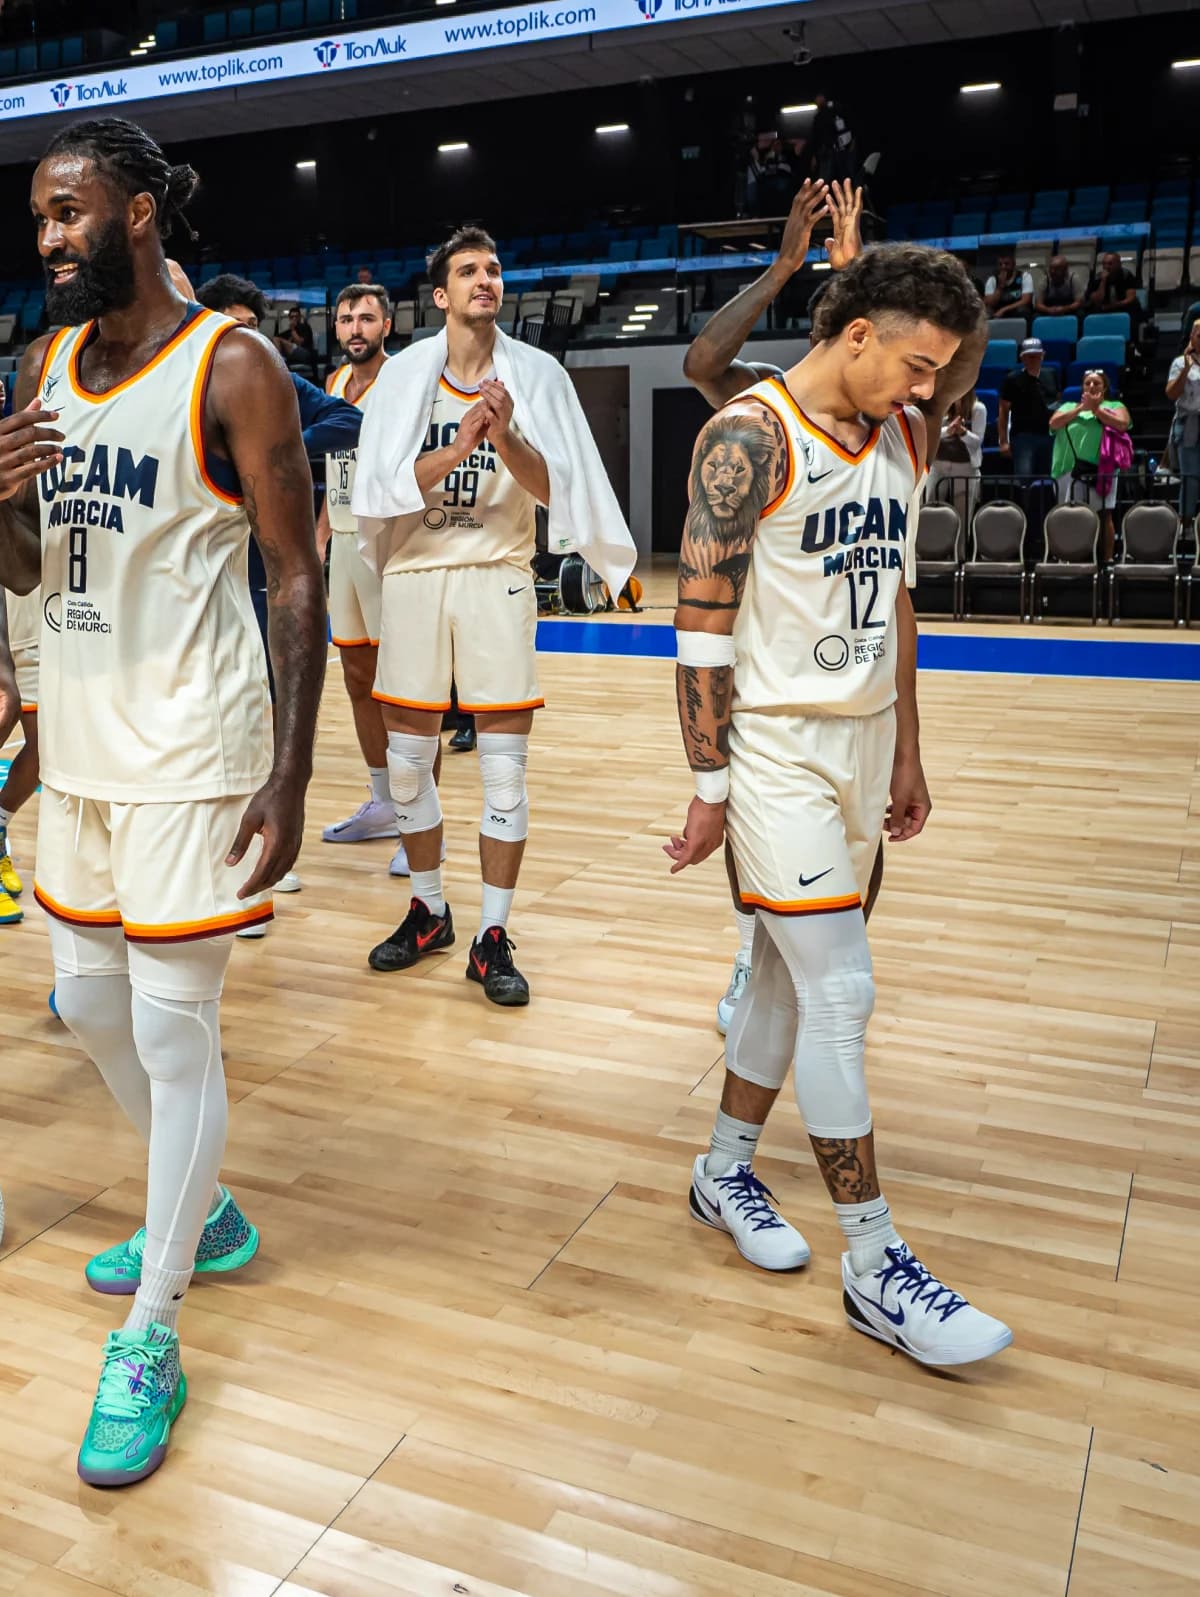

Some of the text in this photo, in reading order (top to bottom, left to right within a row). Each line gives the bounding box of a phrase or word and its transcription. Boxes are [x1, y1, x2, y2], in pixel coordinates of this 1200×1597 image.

[444, 6, 597, 43] www.toplik.com
[158, 56, 283, 86] www.toplik.com
[40, 444, 160, 509] UCAM
[339, 461, 348, 489] 15
[443, 471, 479, 507] 99
[48, 499, 124, 534] MURCIA
[69, 527, 87, 594] 8
[67, 608, 101, 621] REGIÓN
[845, 571, 886, 630] 12
[78, 621, 111, 634] MURCI
[854, 642, 884, 655] REGI
[855, 655, 871, 664] DE
